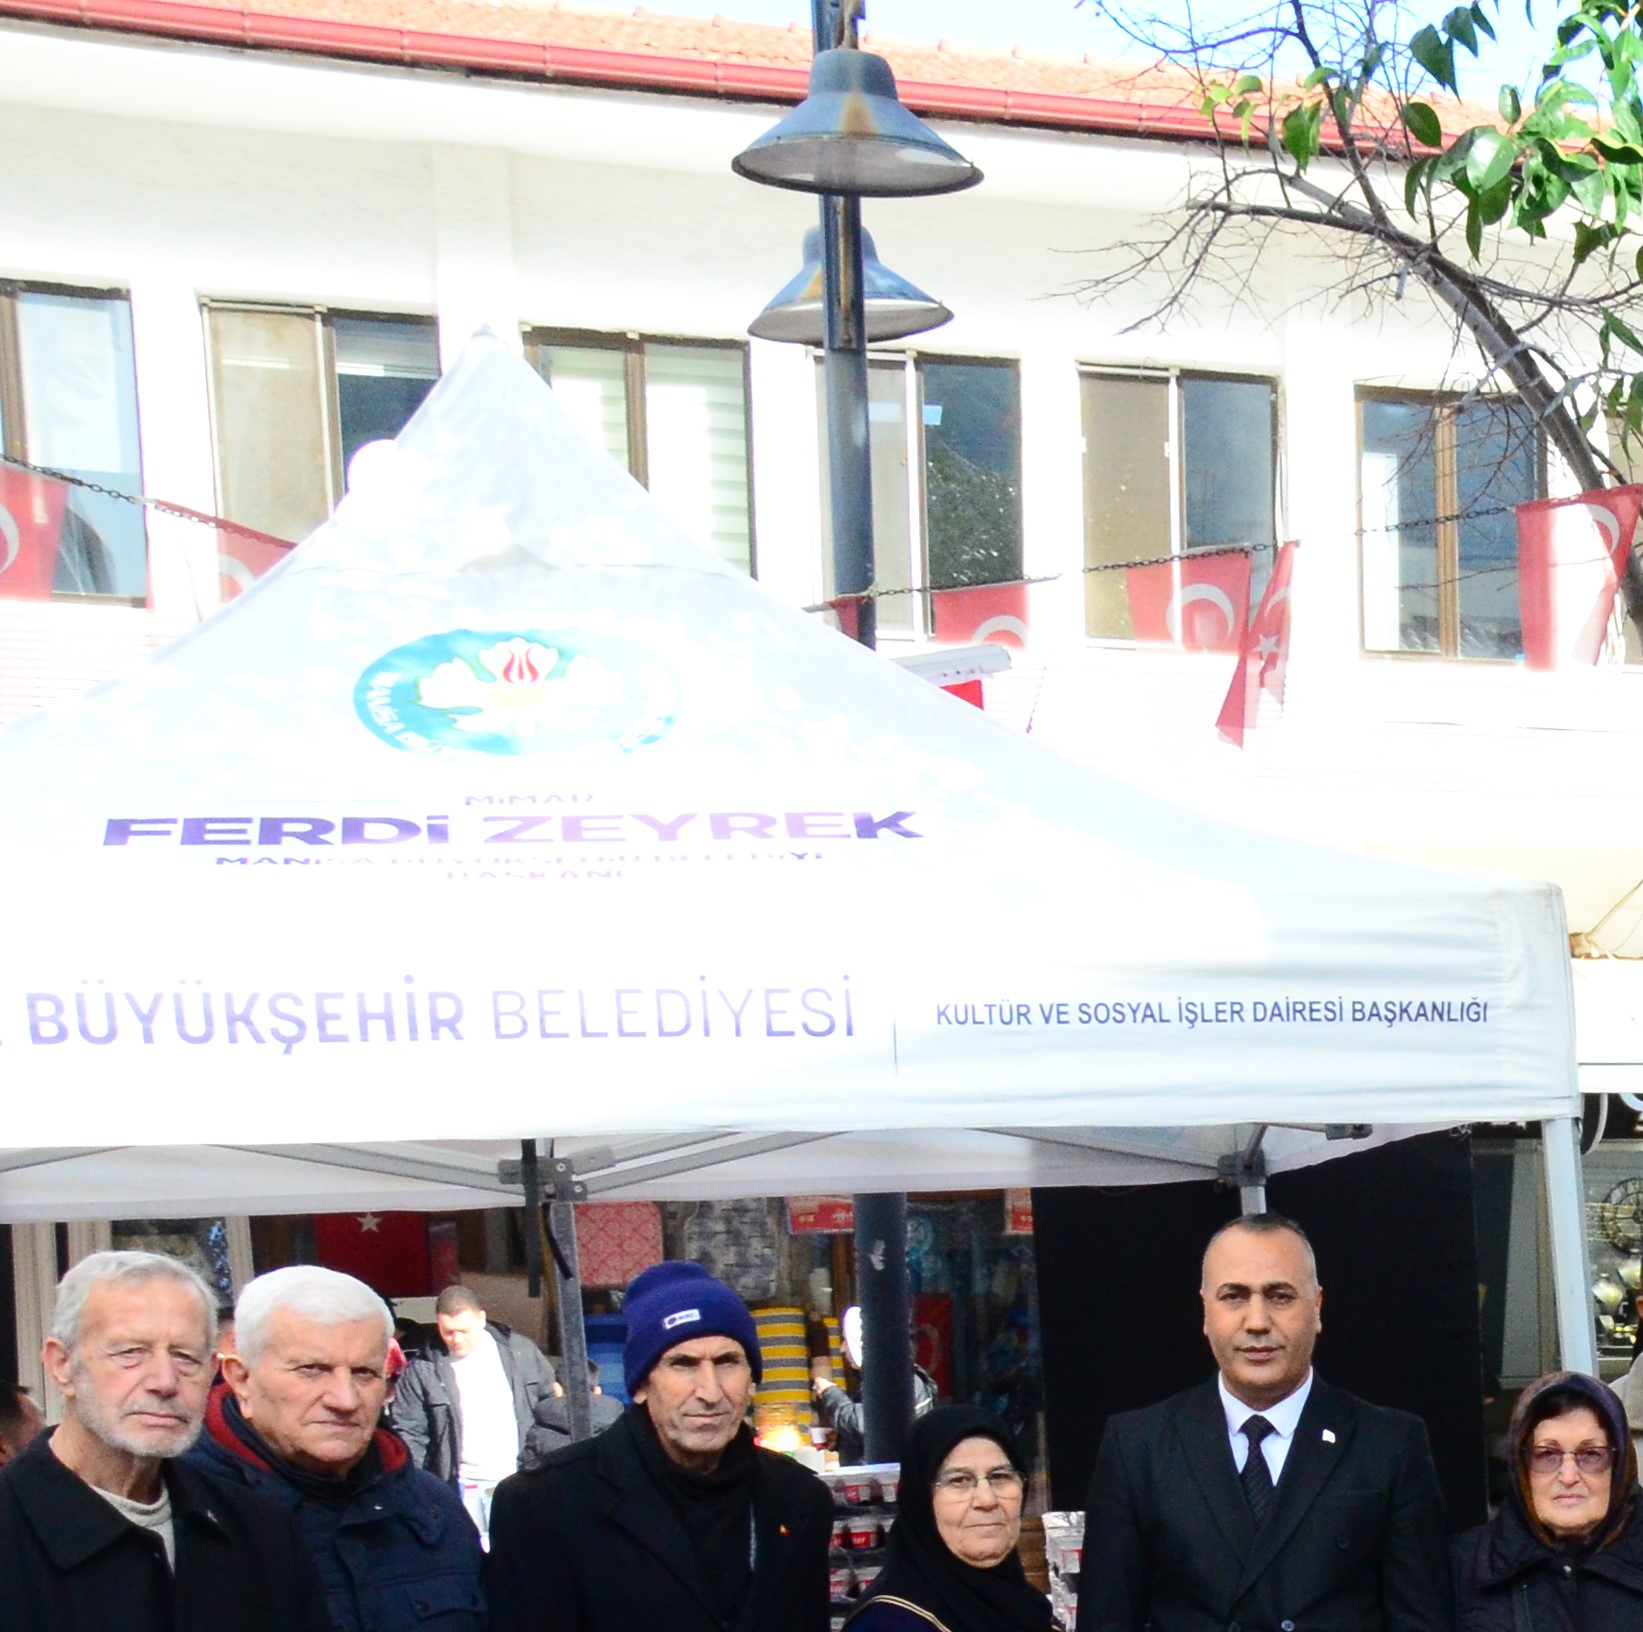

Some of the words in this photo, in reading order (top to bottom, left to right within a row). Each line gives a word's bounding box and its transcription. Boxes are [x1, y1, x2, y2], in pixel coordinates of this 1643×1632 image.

[103, 813, 450, 846] FERDİ
[483, 811, 926, 843] ZEYREK
[26, 973, 465, 1056] BÜYÜKŞEHİR
[493, 973, 856, 1040] BELEDİYESİ
[936, 999, 1032, 1026] KÜLTÜR
[1039, 1003, 1070, 1025] VE
[1077, 1002, 1171, 1025] SOSYAL
[1177, 996, 1245, 1029] İŞLER
[1252, 996, 1343, 1023] DAİRESİ
[1351, 996, 1488, 1028] BAŞKANLIĞI
